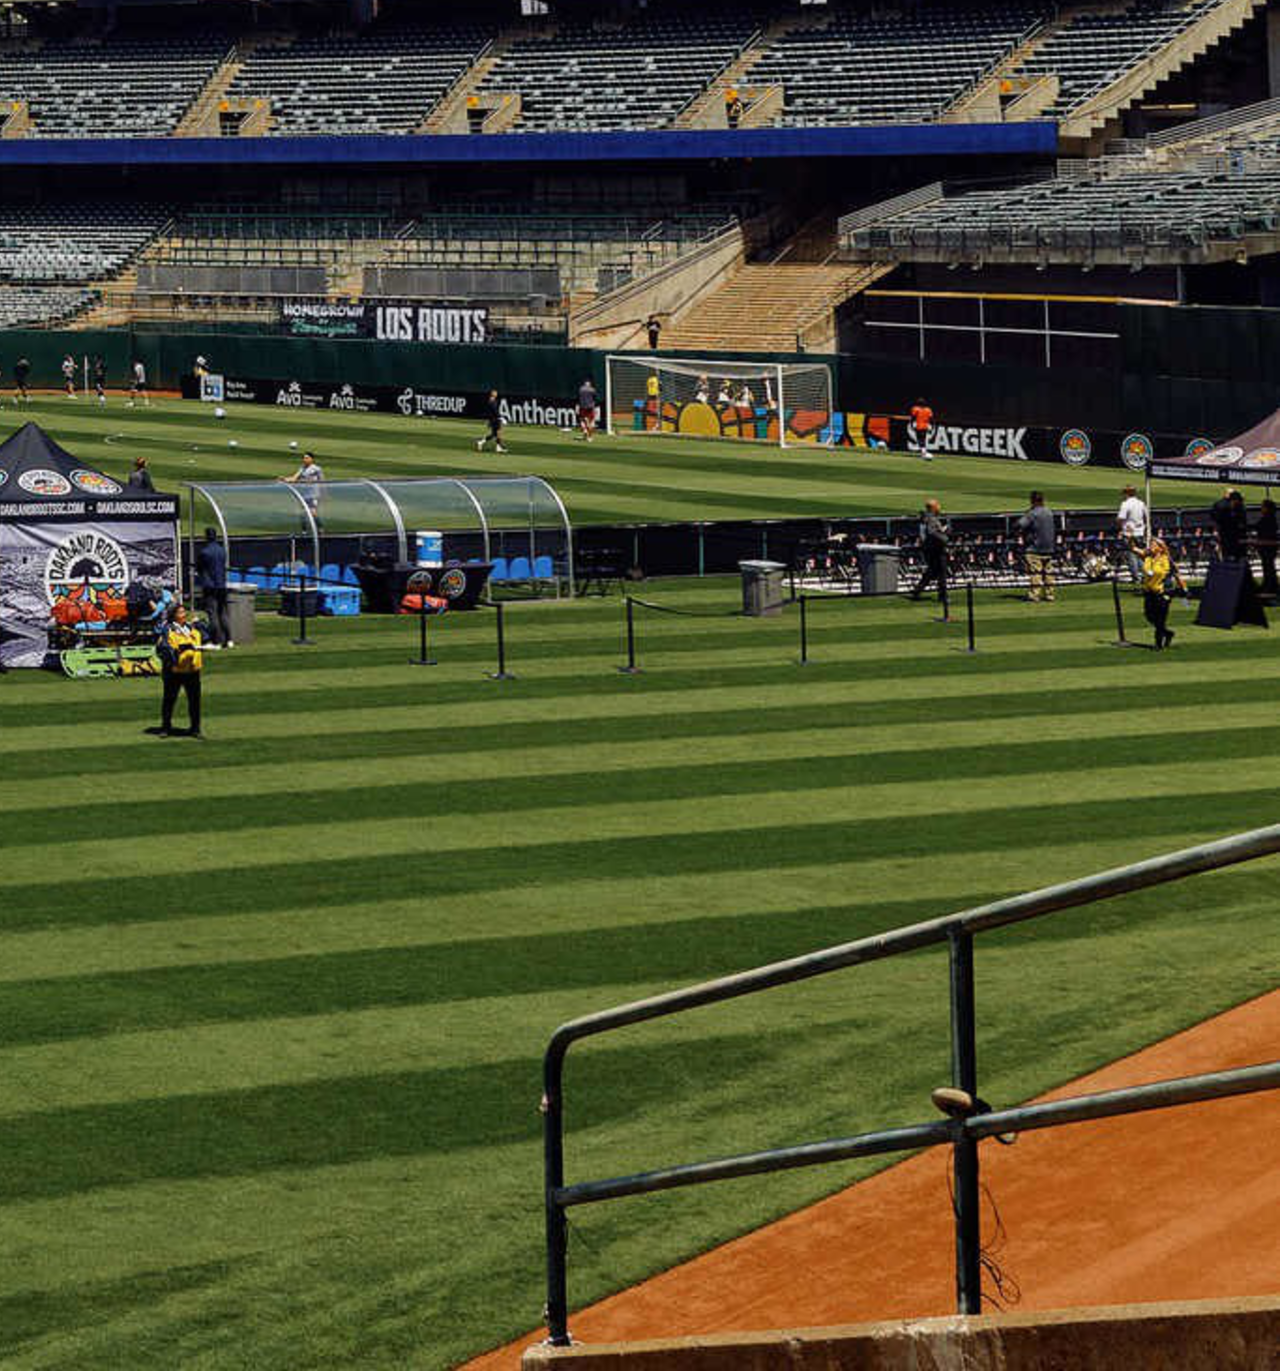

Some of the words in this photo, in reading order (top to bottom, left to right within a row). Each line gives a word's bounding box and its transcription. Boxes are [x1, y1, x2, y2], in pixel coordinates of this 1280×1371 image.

[283, 304, 364, 318] HOMEGROWN
[376, 306, 413, 340] LOS
[417, 309, 486, 343] ROOTS
[414, 394, 467, 413] THREDUP
[498, 398, 577, 426] Anthem
